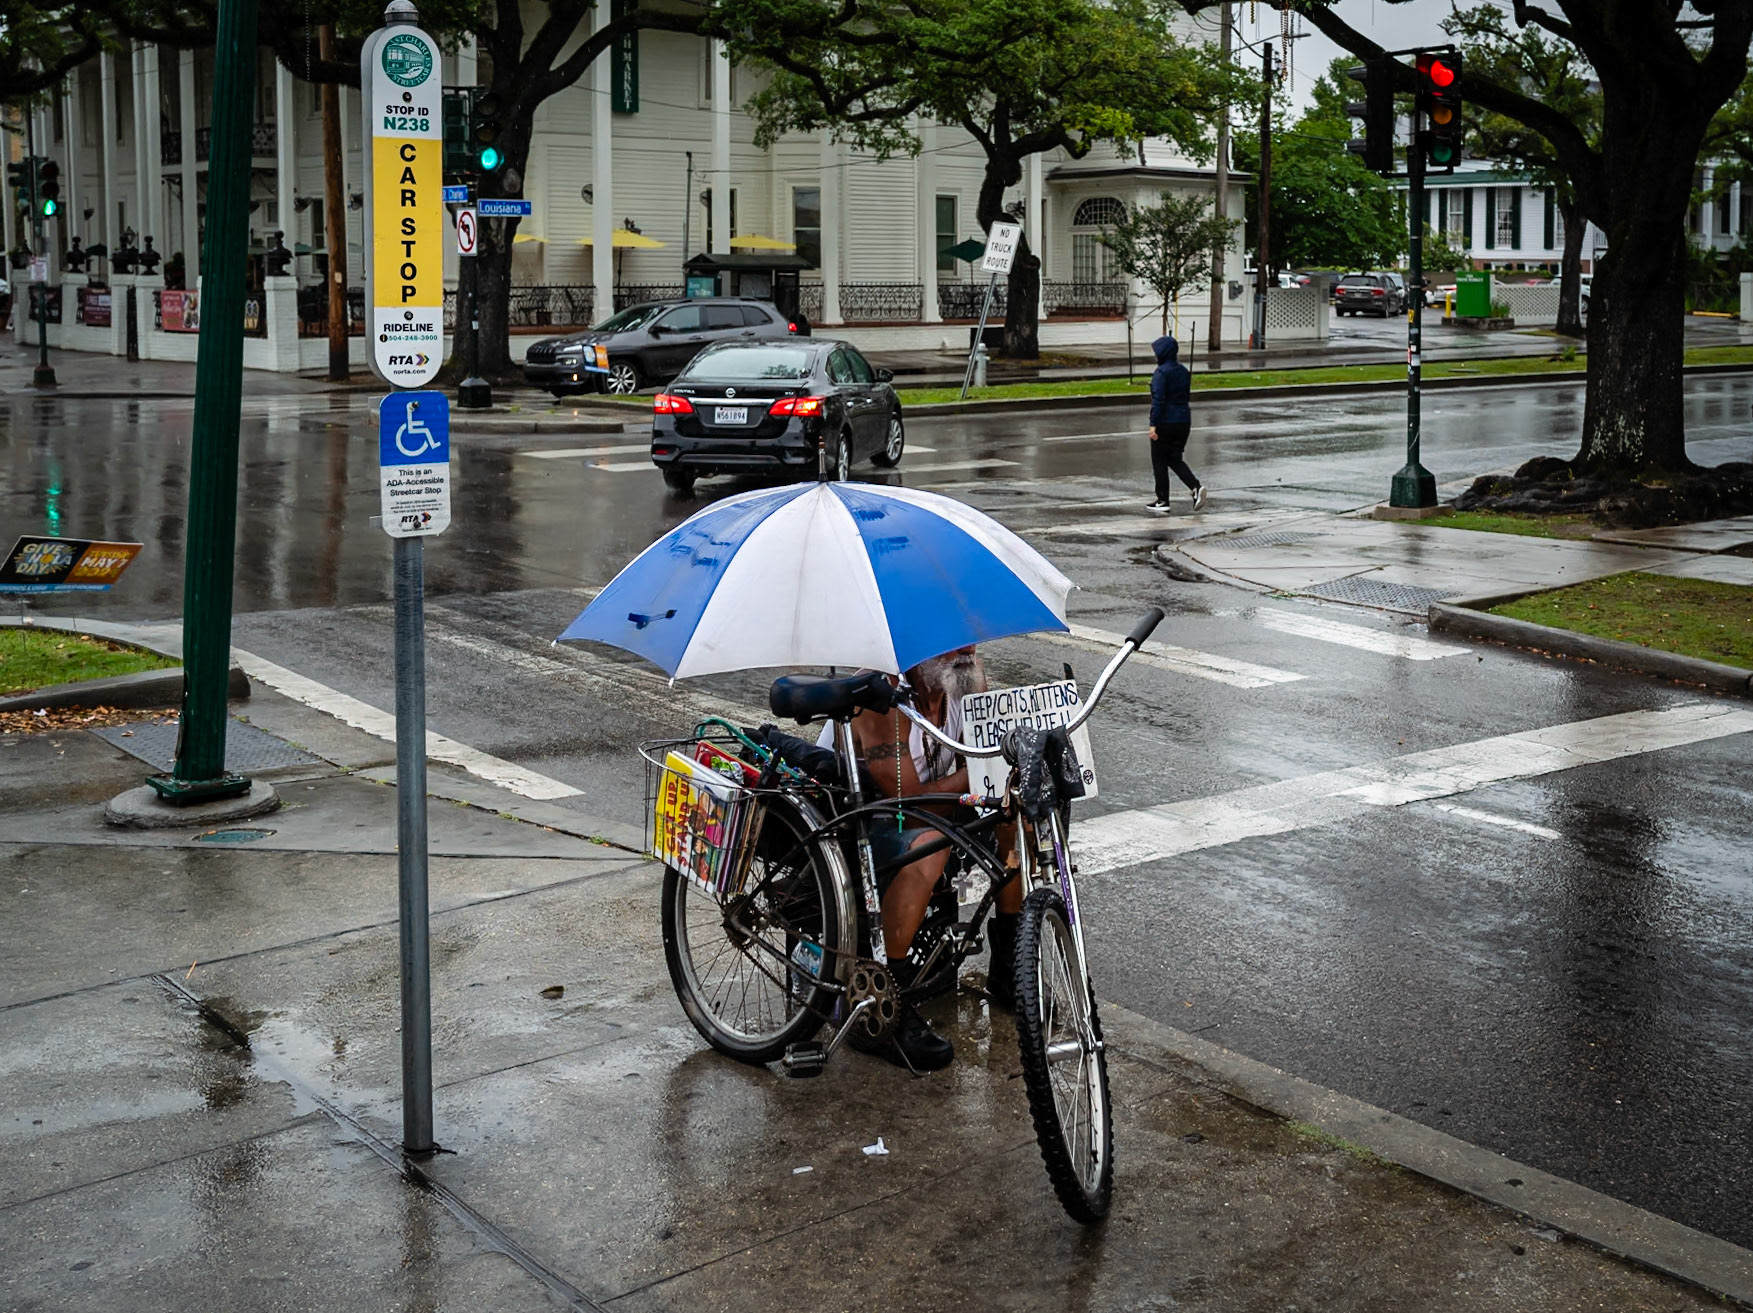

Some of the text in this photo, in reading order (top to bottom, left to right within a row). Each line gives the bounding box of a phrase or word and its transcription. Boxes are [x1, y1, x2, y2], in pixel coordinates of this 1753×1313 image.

[385, 105, 430, 116] STOP ID
[383, 116, 430, 132] N238
[479, 201, 522, 214] Louisiana
[399, 143, 417, 303] CAR STOP
[1000, 228, 1010, 239] NO
[991, 241, 1012, 254] TRUCK
[986, 256, 1008, 268] ROUTE
[383, 323, 434, 332] RIDELINE
[388, 355, 414, 366] RTA
[415, 468, 422, 476] is
[386, 477, 445, 487] ADA-Accessible
[390, 486, 442, 497] Streetcar Stop
[401, 514, 419, 523] RTA
[23, 543, 64, 555] GIVE
[81, 556, 116, 567] MAY
[16, 563, 49, 573] DAY
[665, 811, 677, 853] GET
[677, 801, 690, 867] STAND
